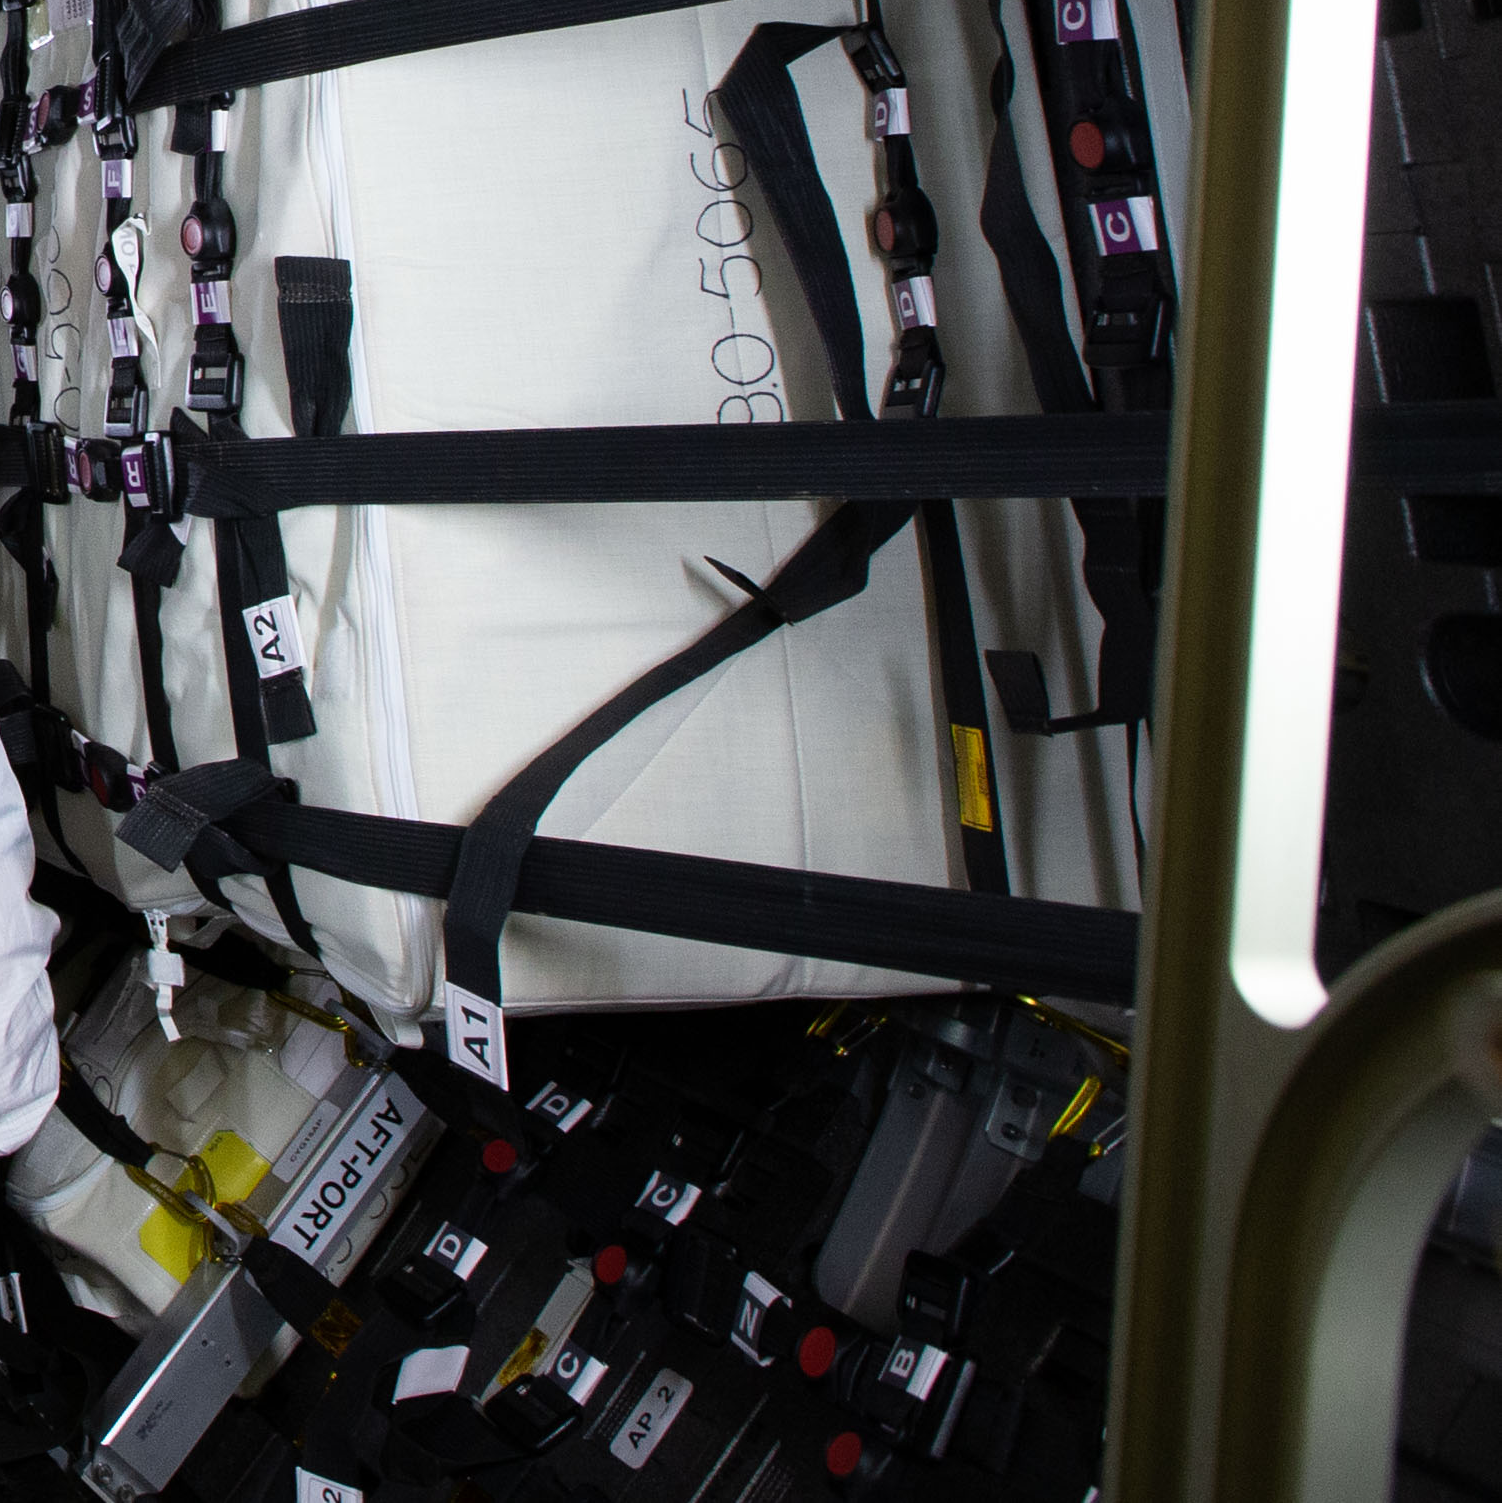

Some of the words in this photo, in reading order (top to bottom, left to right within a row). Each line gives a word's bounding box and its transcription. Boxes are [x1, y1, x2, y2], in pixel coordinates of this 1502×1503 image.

[1063, 0, 1087, 28] C
[83, 92, 93, 111] S
[875, 102, 890, 126] D
[107, 169, 120, 188] F
[1105, 211, 1132, 240] C
[201, 292, 215, 313] E
[898, 289, 918, 316] D
[68, 454, 77, 480] R
[125, 461, 140, 488] R
[253, 609, 285, 664] A2
[462, 1005, 490, 1070] A1
[550, 1095, 572, 1115] D
[293, 1097, 405, 1251] AFT-PORT
[652, 1185, 679, 1207] C
[440, 1235, 463, 1258] D
[557, 1351, 581, 1377] C
[891, 1348, 917, 1376] B
[626, 1383, 676, 1451] AP_2
